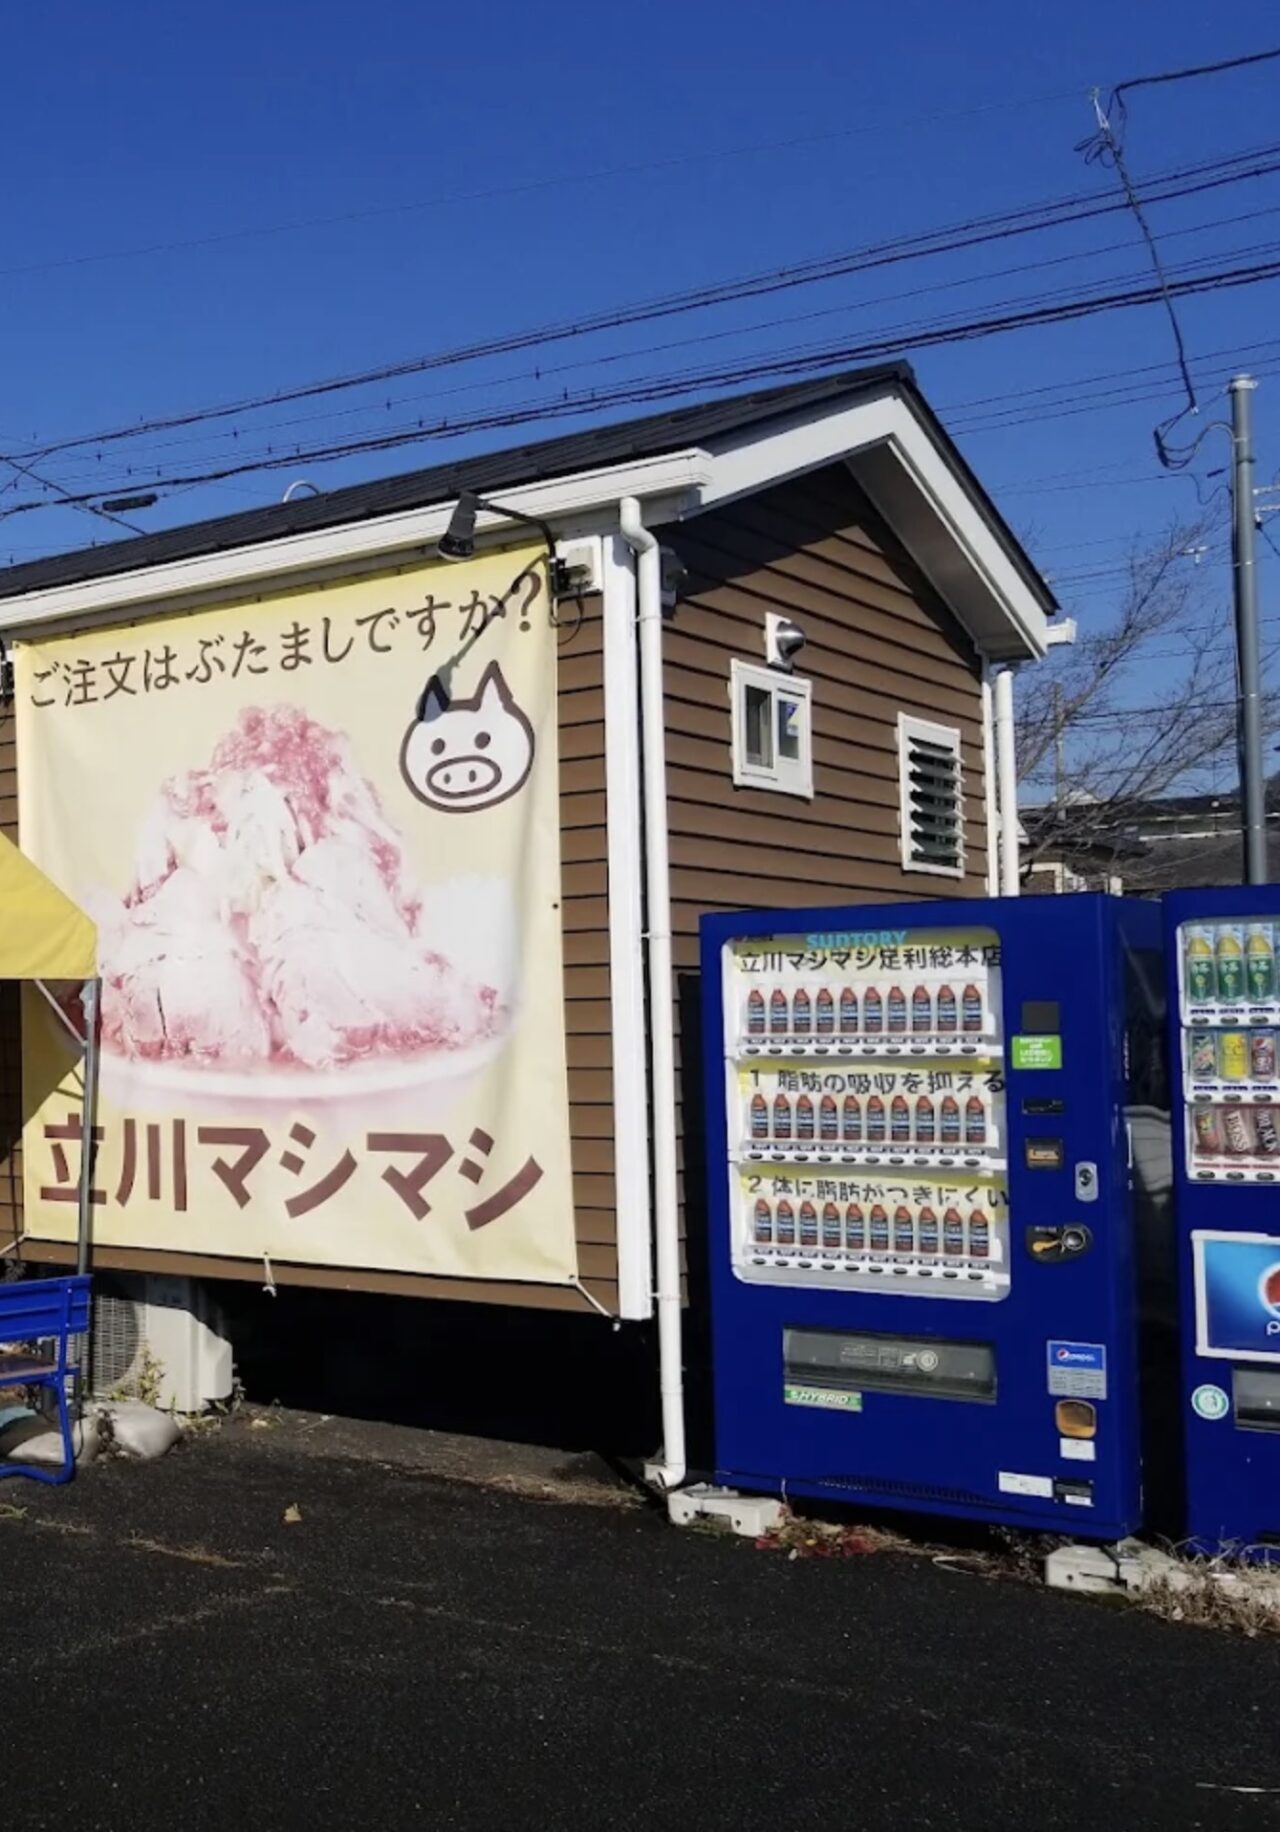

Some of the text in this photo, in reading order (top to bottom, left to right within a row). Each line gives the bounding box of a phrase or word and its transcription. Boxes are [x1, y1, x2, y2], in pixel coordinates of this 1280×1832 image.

[30, 571, 542, 708] ご注文はぶたましですか?
[740, 944, 1003, 973] 立川マシマシ足利総本店
[40, 1112, 545, 1231] 立川マシマシ
[747, 1175, 762, 1193] 2
